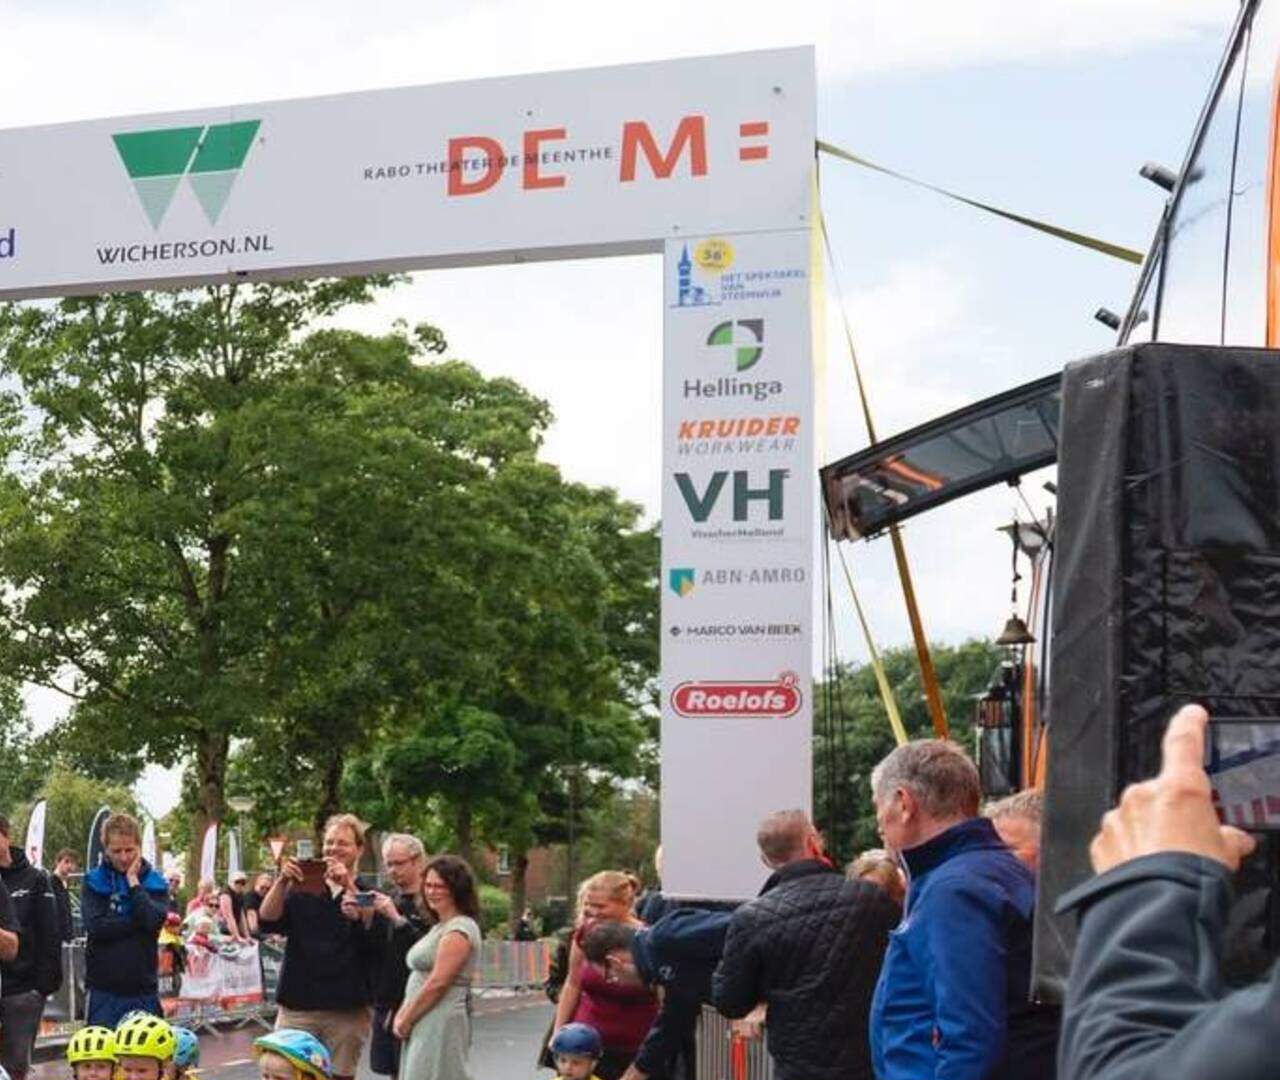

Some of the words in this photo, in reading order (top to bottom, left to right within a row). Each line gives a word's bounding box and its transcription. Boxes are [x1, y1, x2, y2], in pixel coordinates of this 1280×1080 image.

[363, 163, 411, 181] RABO
[413, 157, 493, 177] THEATER
[497, 154, 520, 168] DE
[524, 146, 613, 167] MEENTHE
[95, 233, 275, 267] WICHERSON.NL
[683, 377, 783, 401] Hellinga
[677, 415, 801, 440] KRUIDER
[677, 437, 797, 456] WORKWEAR
[672, 468, 786, 523] VH
[686, 623, 737, 637] MARCO
[737, 622, 767, 636] VAN
[767, 621, 803, 637] BEEK
[685, 688, 788, 711] Roelofs
